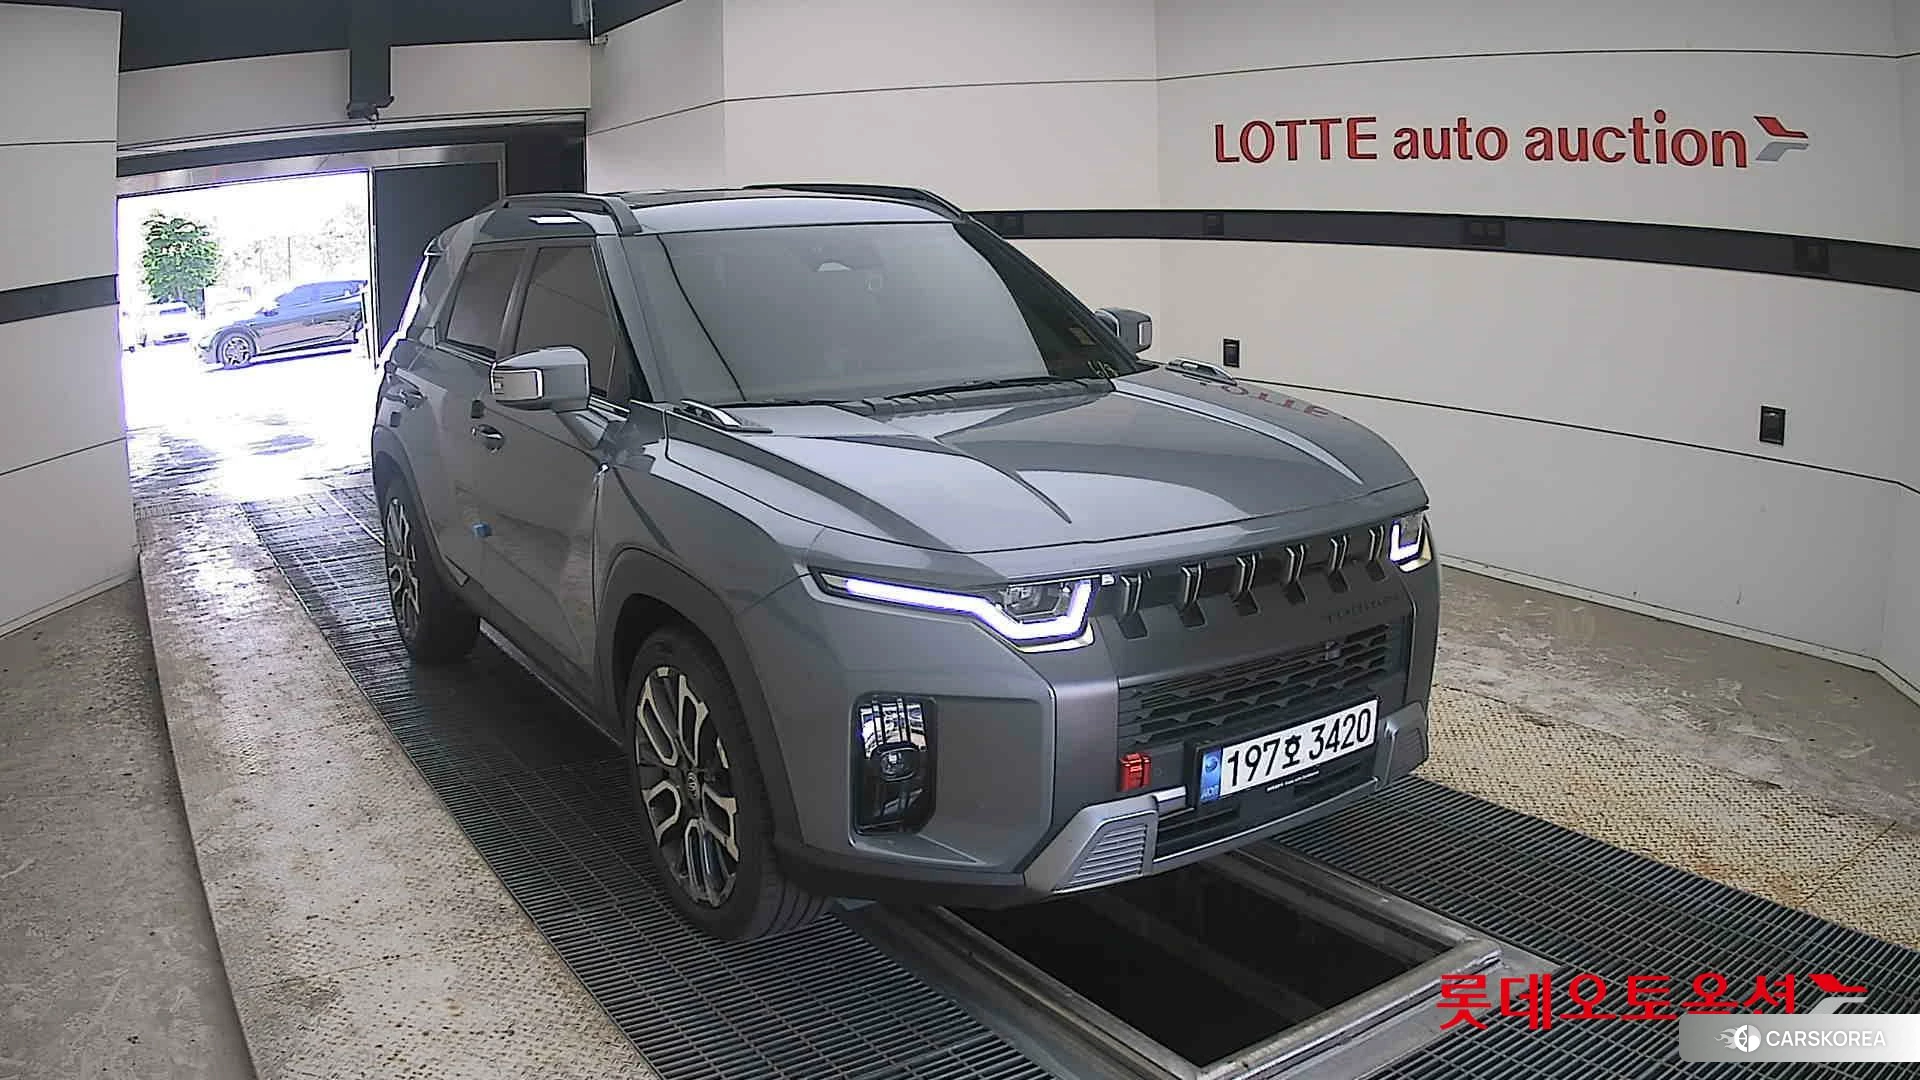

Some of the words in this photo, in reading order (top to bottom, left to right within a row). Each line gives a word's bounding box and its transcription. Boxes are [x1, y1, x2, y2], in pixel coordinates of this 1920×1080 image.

[1214, 116, 1377, 163] LOTTE
[1393, 117, 1508, 161] auto
[1524, 109, 1748, 168] auction
